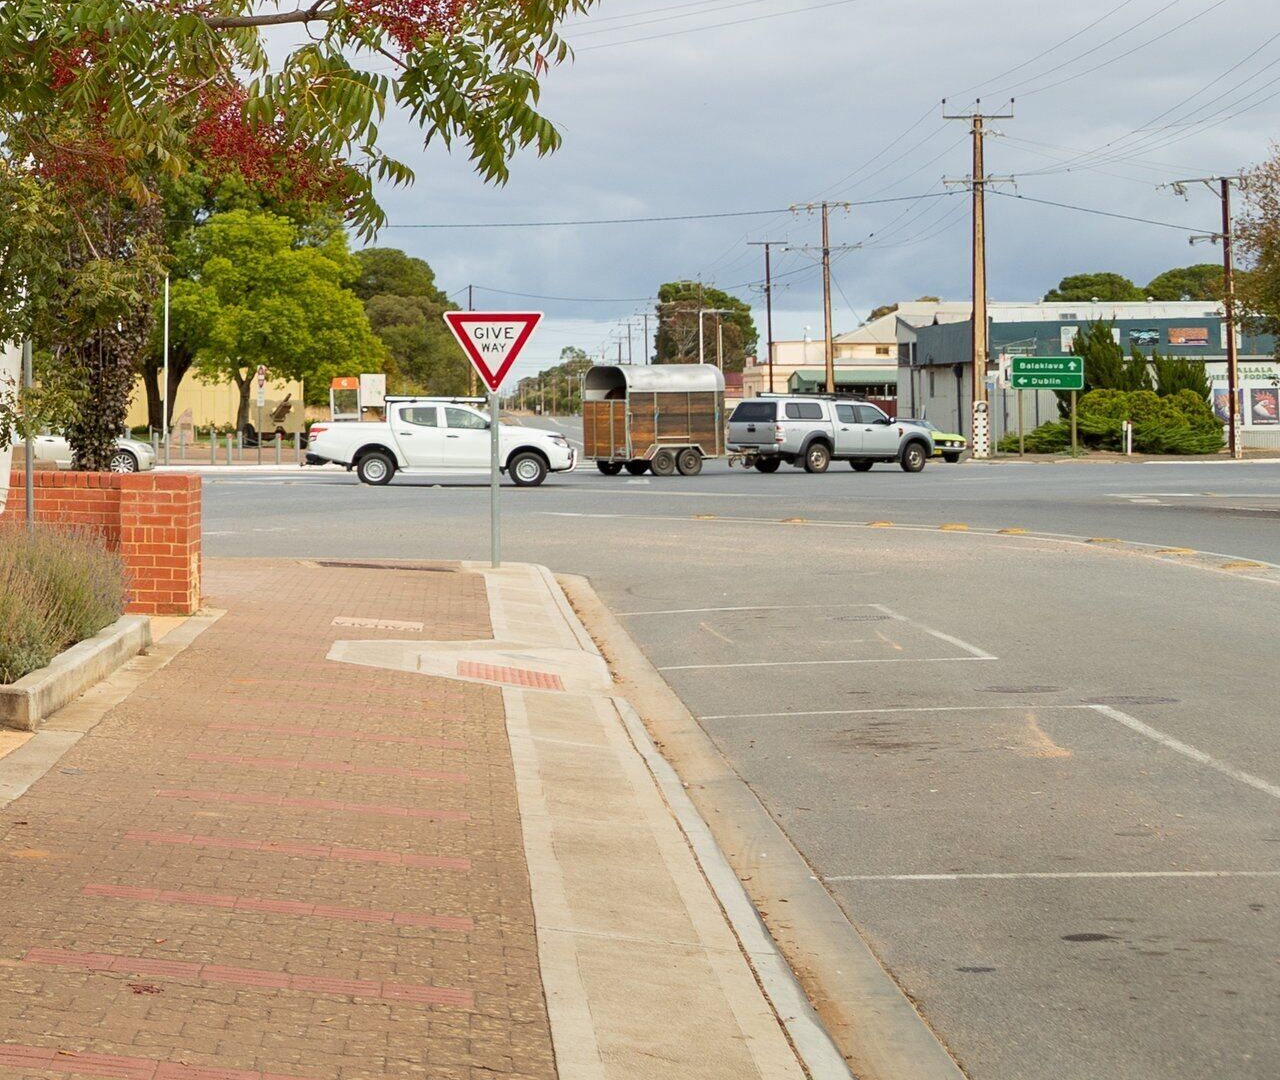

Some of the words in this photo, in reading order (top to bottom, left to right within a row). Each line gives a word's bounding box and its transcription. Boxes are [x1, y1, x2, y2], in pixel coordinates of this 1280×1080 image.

[474, 327, 515, 339] GIVE
[481, 343, 507, 353] WAY
[1031, 377, 1062, 385] Dublin
